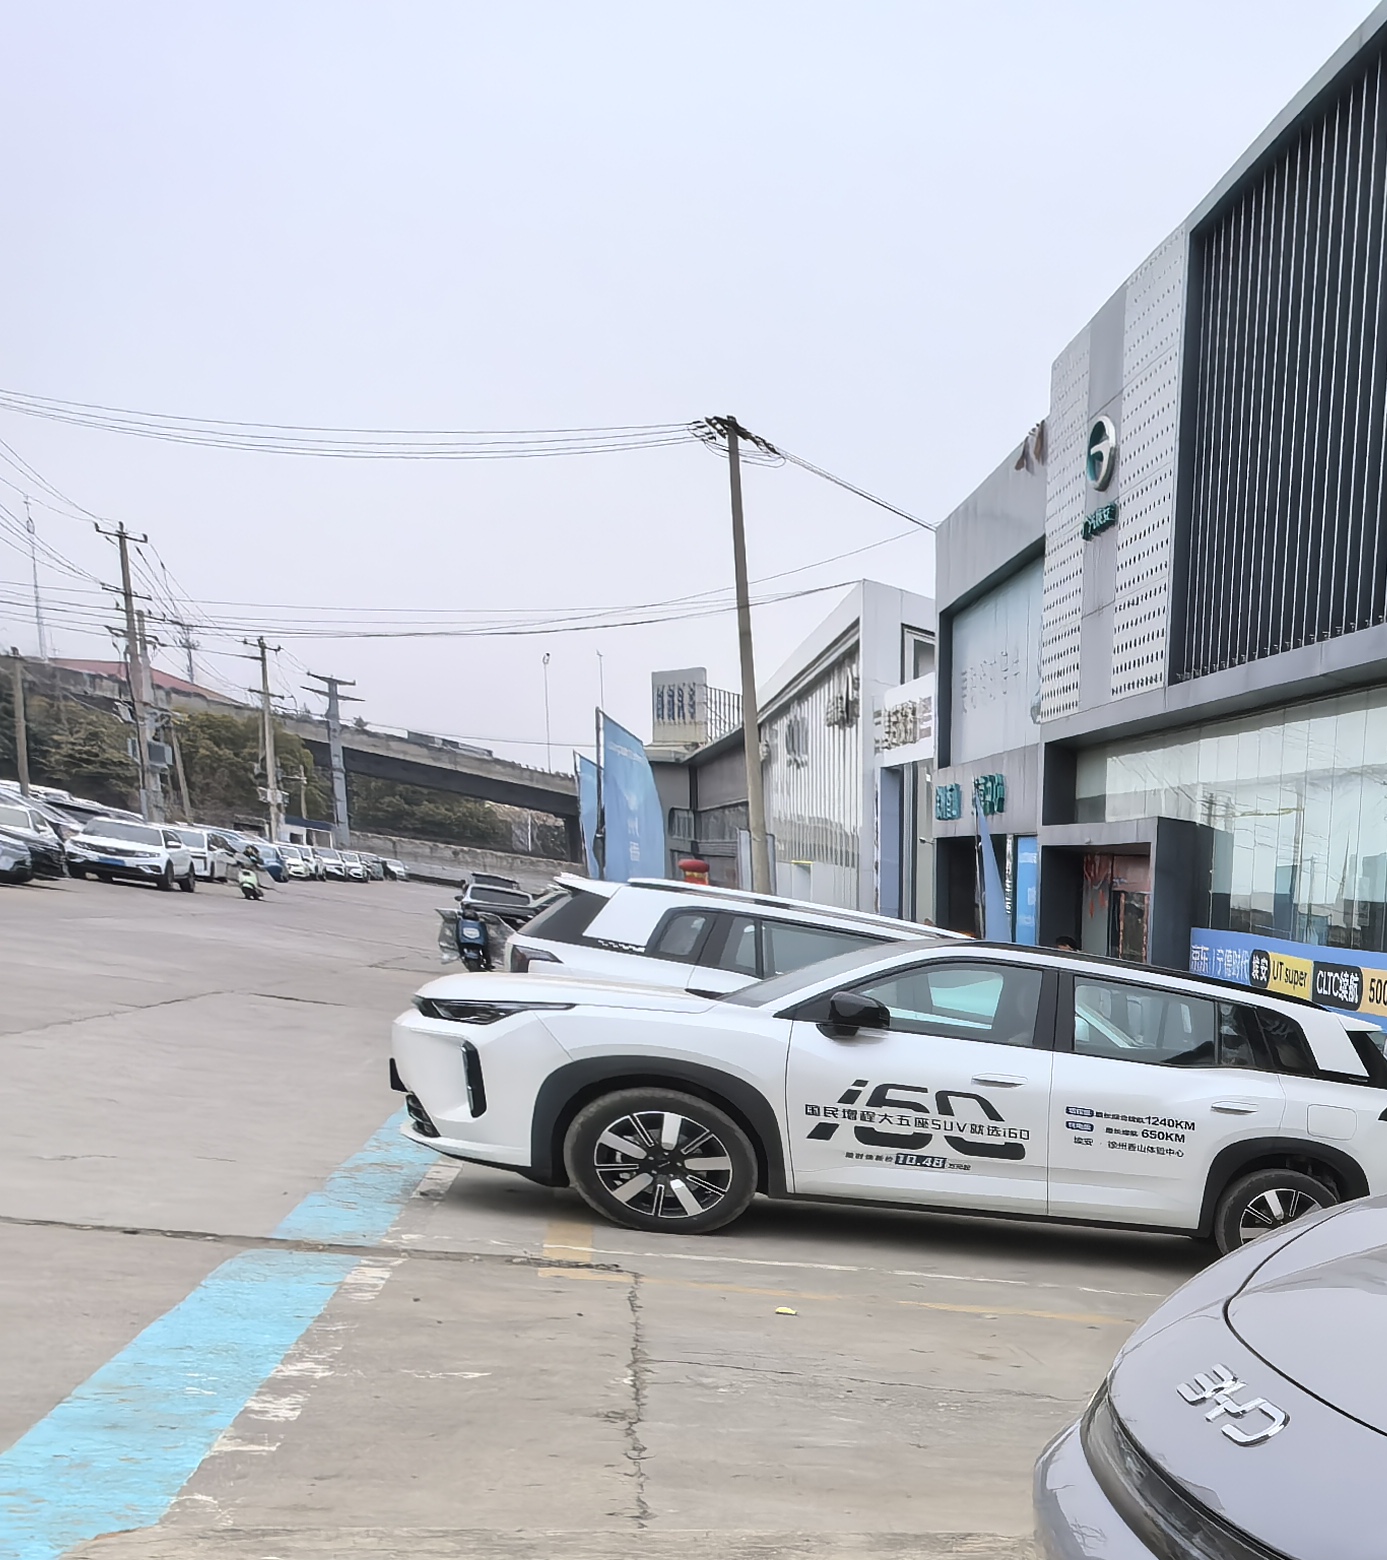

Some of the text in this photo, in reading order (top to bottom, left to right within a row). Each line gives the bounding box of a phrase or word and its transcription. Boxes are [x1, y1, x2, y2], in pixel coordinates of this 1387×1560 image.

[1272, 960, 1284, 981] UT
[1284, 965, 1309, 990] super
[1316, 970, 1359, 1003] CLTC续航
[1141, 1129, 1185, 1143] 650KM
[1176, 1363, 1291, 1447] BYD
